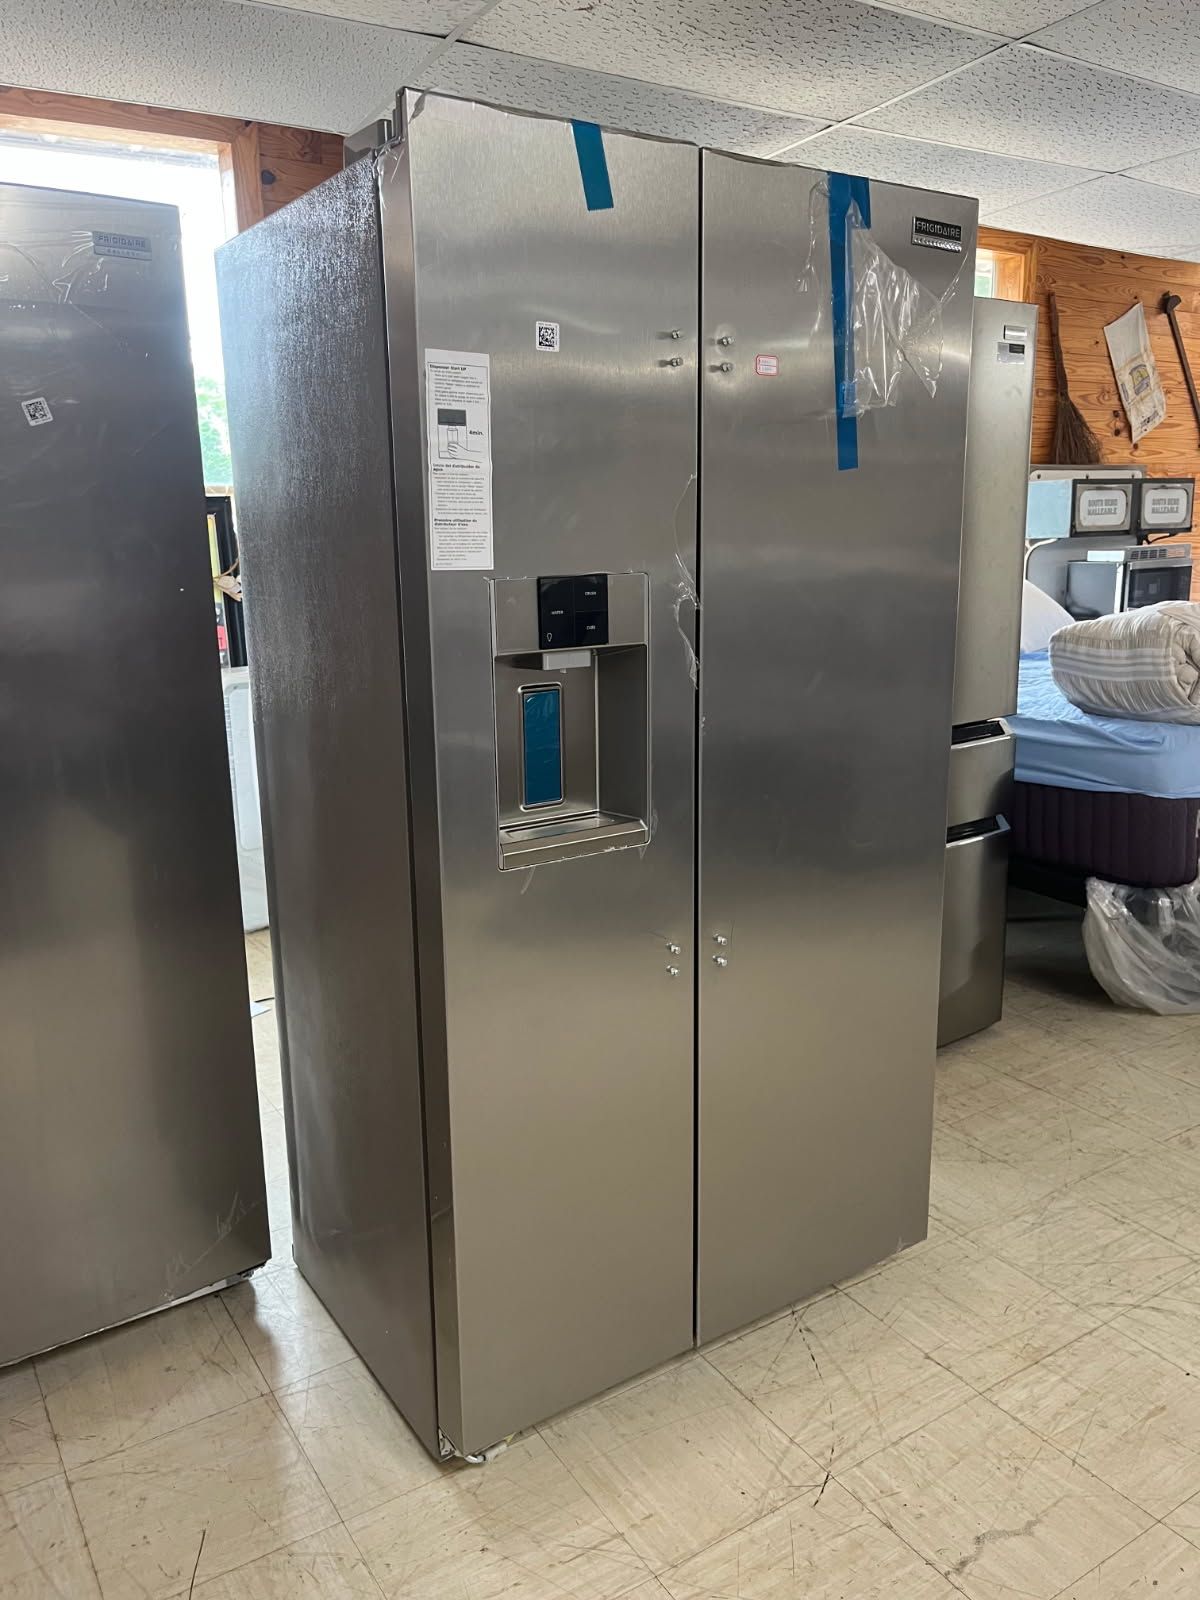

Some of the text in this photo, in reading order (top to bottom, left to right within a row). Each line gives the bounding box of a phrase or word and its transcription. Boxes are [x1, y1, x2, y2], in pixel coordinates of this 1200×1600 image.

[916, 221, 960, 238] FRIGIDAIRE
[98, 235, 146, 248] FRIGIDAIRE
[1088, 499, 1103, 507] SOUTH
